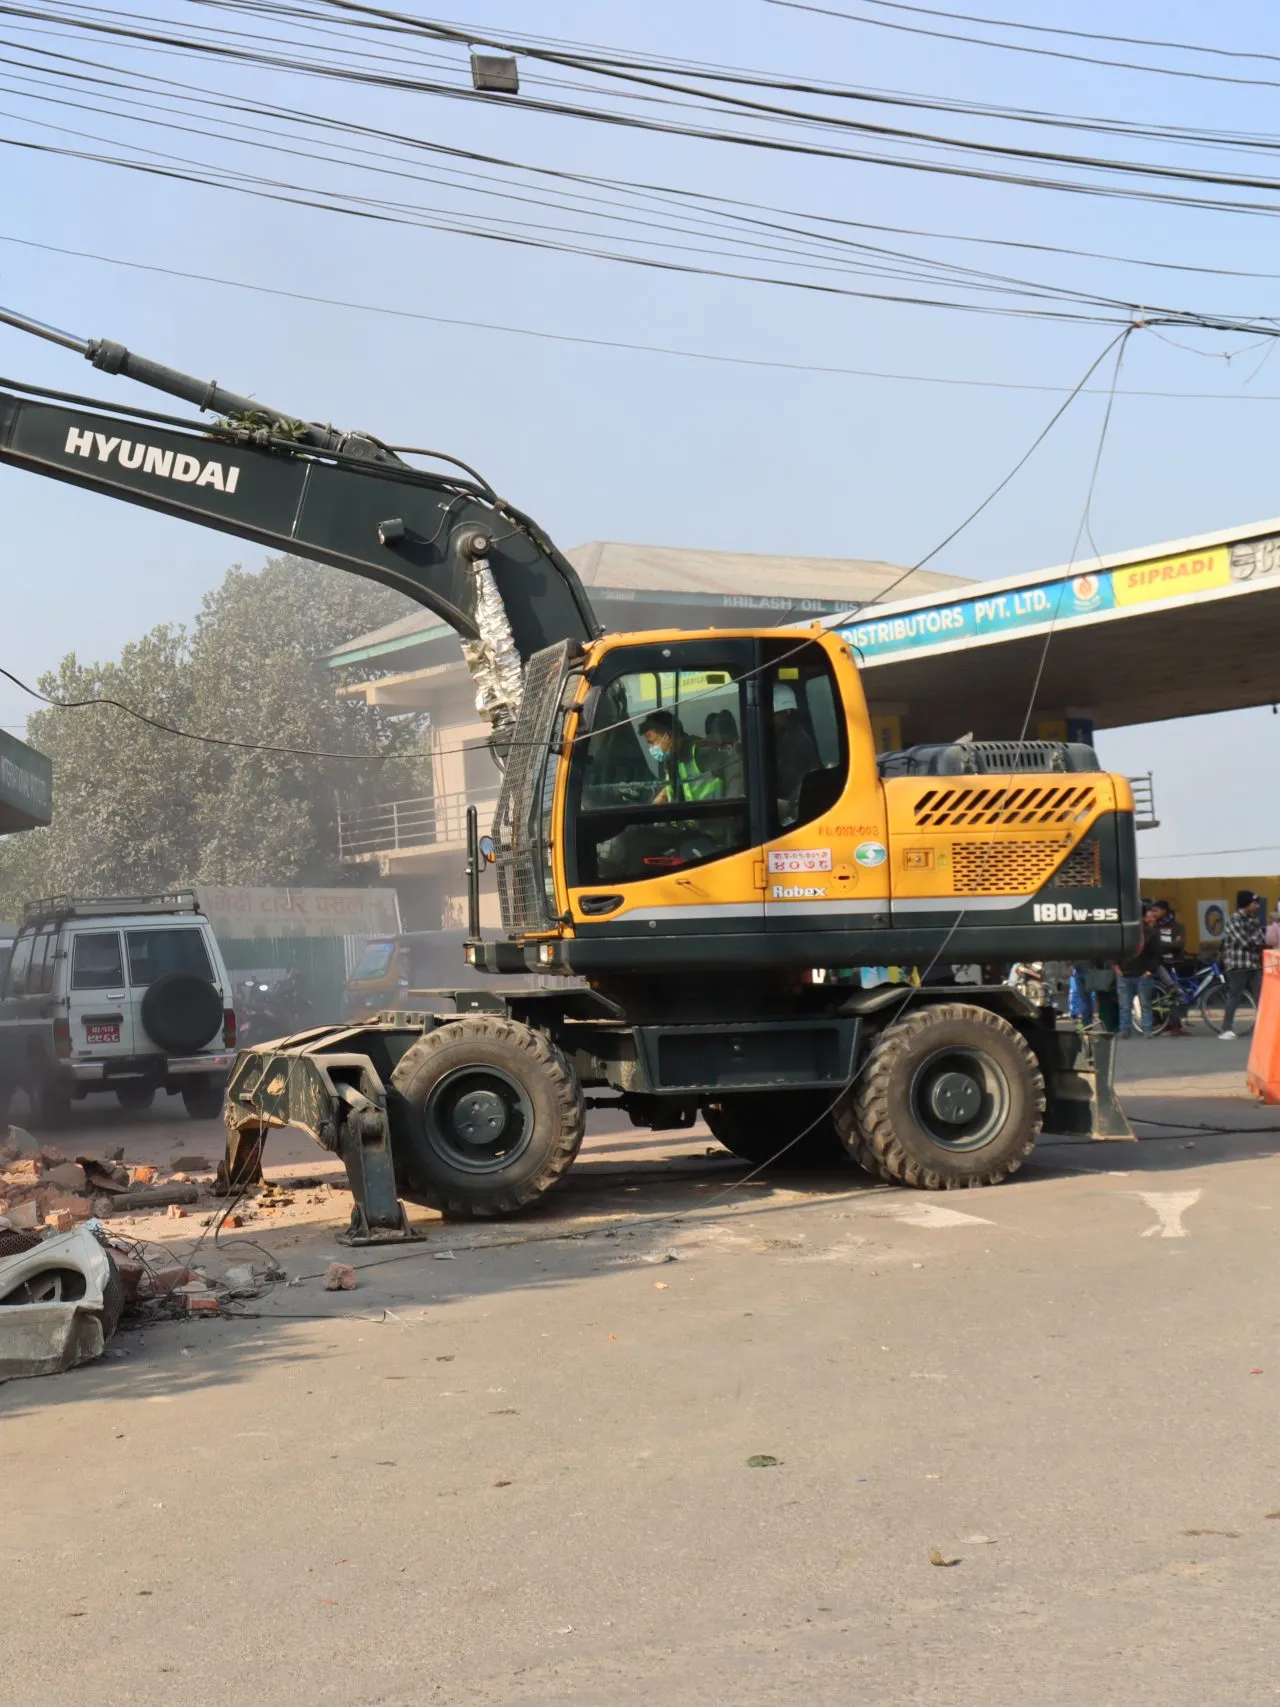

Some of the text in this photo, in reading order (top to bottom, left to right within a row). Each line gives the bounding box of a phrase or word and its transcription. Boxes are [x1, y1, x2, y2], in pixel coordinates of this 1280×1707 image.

[64, 426, 240, 494] HYUNDAI
[1127, 557, 1214, 588] SIPRADI
[801, 599, 826, 612] OIL
[841, 607, 965, 648] DISTRIBUTORS
[975, 598, 1011, 624] PVT.
[1014, 589, 1052, 615] LTD.
[772, 885, 827, 898] Robex
